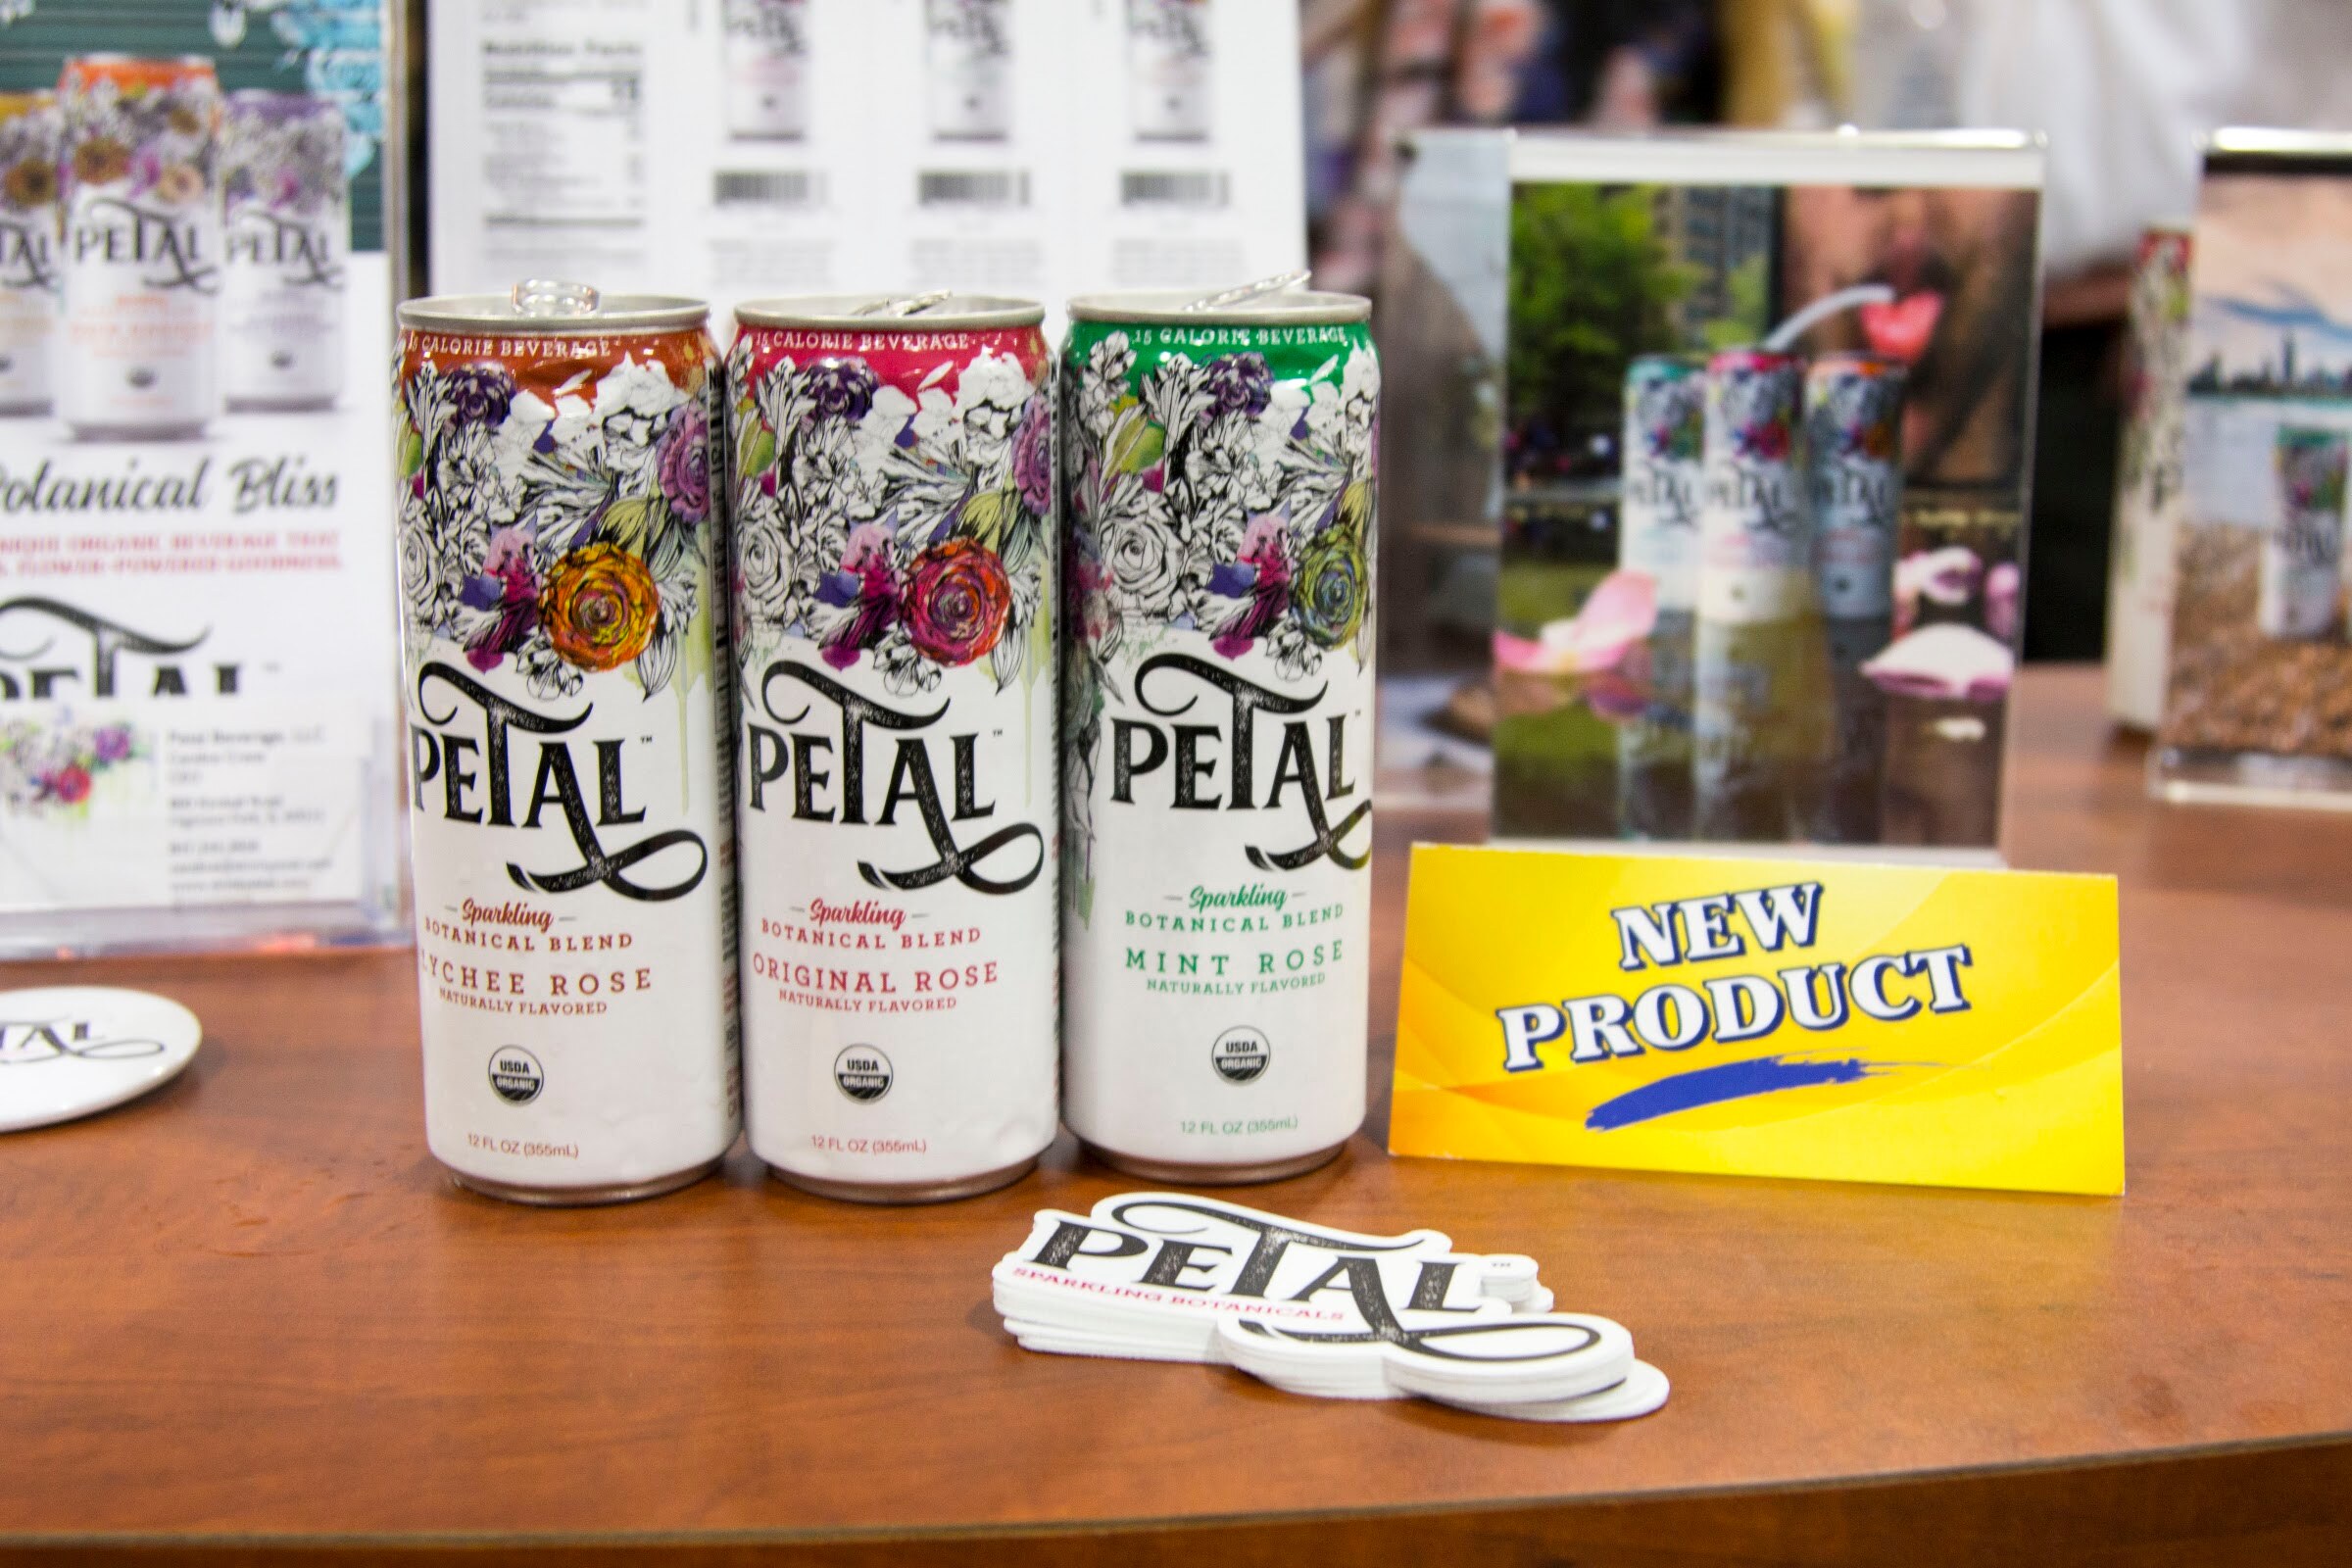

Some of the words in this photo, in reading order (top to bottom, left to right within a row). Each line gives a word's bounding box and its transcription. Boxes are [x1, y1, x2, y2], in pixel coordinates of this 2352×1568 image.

[74, 197, 220, 295] PETAL
[421, 334, 493, 356] CALORIE
[500, 339, 612, 359] BEVERAGE
[773, 329, 853, 351] CALORIE
[860, 332, 969, 352] BEVERAGE
[1159, 326, 1250, 346] CALORIE
[1256, 326, 1347, 345] BEVERAGE
[0, 457, 210, 512] otanical
[229, 456, 340, 514] Bliss
[1110, 653, 1372, 871] PETAL
[411, 661, 708, 903] PETAL
[747, 660, 1045, 896] PETAL
[1189, 884, 1288, 913] Sparkling
[461, 897, 554, 932] Sparkling
[808, 898, 906, 931] Sparkling
[1125, 910, 1269, 932] BOTANICAL
[1283, 904, 1344, 928] BLEND
[1610, 881, 1824, 971] NEW
[425, 916, 535, 952] BOTANICAL
[550, 932, 633, 952] BLEND
[761, 918, 886, 950] BOTANICAL
[901, 927, 981, 949] BLEND
[1125, 947, 1230, 975] MINT
[1258, 939, 1343, 974] ROSE
[550, 967, 652, 996] ROSE
[753, 952, 897, 993] ORIGINAL
[914, 961, 998, 993] ROSE
[1147, 979, 1243, 995] NATURALLY
[1250, 972, 1326, 994] FLAVORED
[439, 987, 514, 1013] NATURALLY
[519, 1002, 608, 1015] FLAVORED
[779, 989, 861, 1012] NATURALLY
[868, 997, 956, 1012] FLAVORED
[1494, 943, 1973, 1072] PRODUCT
[1225, 1040, 1258, 1054] USDA
[499, 1059, 530, 1074] USDA
[847, 1058, 879, 1072] USDA
[1221, 1056, 1262, 1070] ORGANIC
[496, 1076, 536, 1091] ORGANIC
[842, 1075, 884, 1089] ORGANIC
[1180, 1120, 1195, 1133] 12
[1200, 1120, 1217, 1133] FL
[1222, 1120, 1243, 1134] OZ
[1248, 1115, 1298, 1133] (355mL)
[467, 1133, 480, 1148] 12
[482, 1136, 499, 1152] FL
[501, 1139, 521, 1155] OZ
[523, 1142, 580, 1157] (355mL)
[811, 1135, 824, 1150] 12
[828, 1138, 844, 1152] FL
[848, 1139, 869, 1153] OZ
[872, 1140, 927, 1155] (355mL)
[1012, 1267, 1163, 1303] SPARKLING
[1169, 1294, 1346, 1322] BOTANICALS
[1031, 1200, 1600, 1361] PETAL
